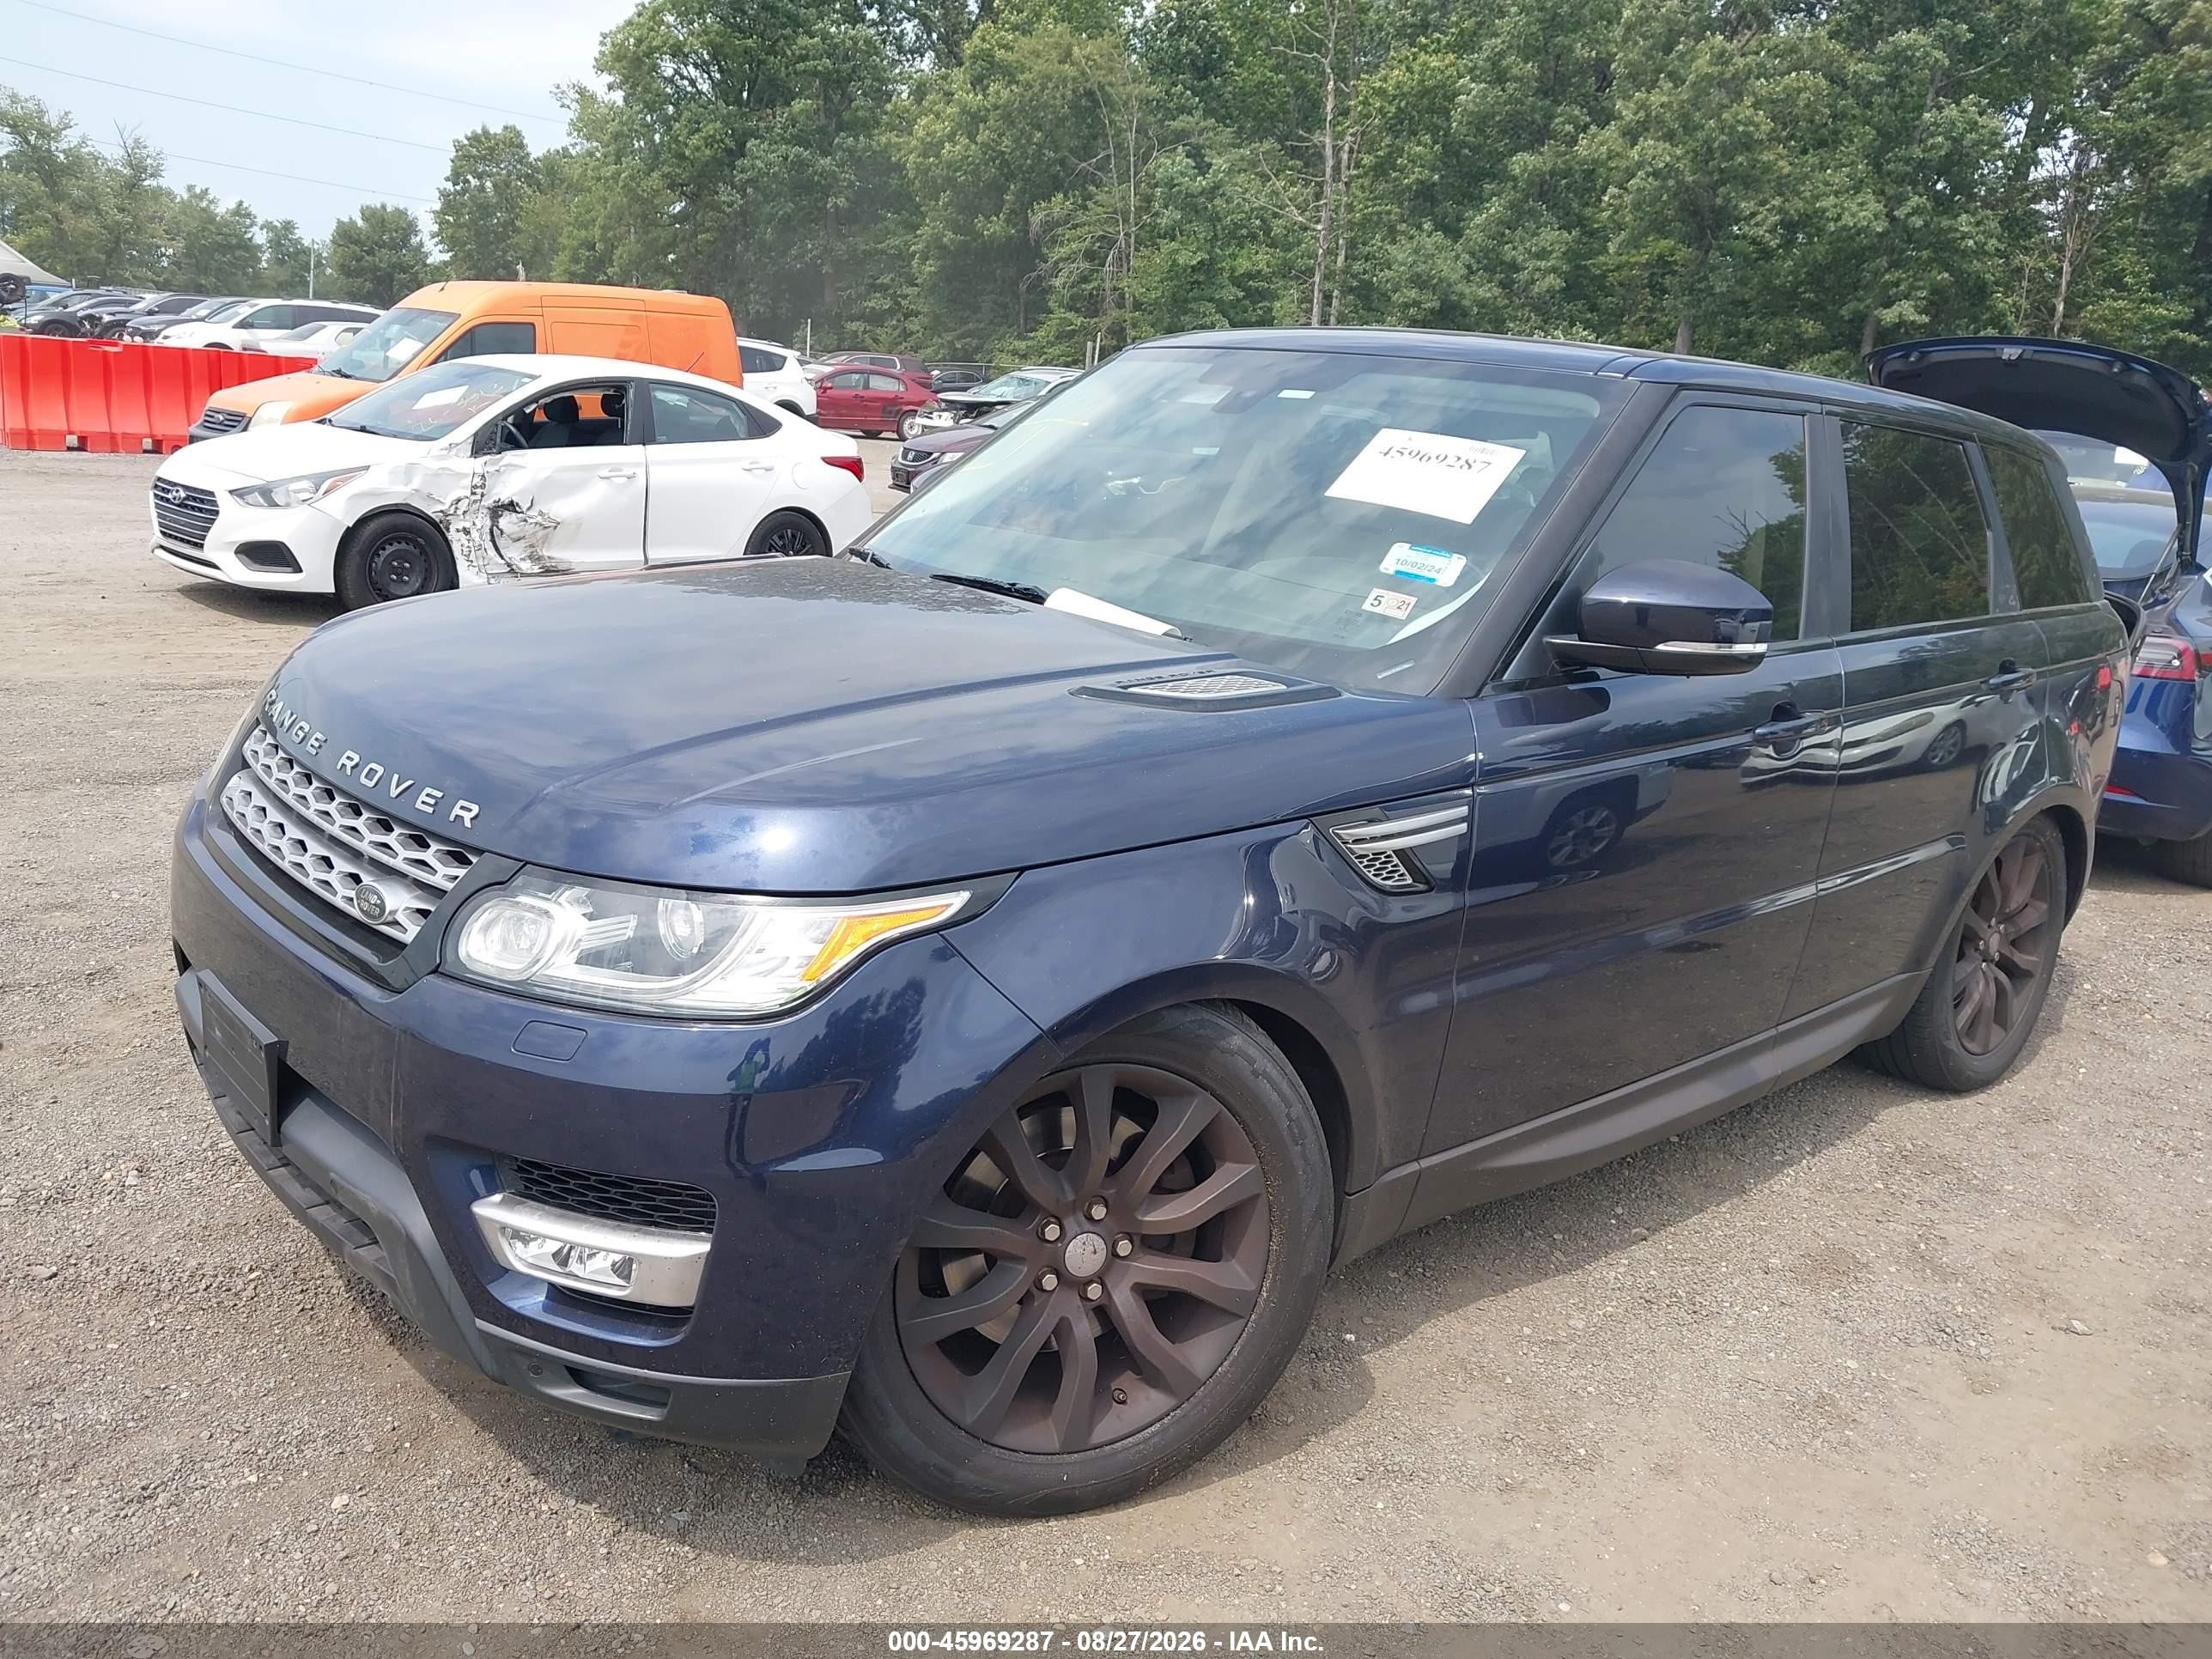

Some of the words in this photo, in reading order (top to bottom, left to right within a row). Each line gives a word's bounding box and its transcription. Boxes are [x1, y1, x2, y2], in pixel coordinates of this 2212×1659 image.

[1379, 446, 1492, 474] 45969287
[1395, 557, 1443, 574] 10/02/24
[1370, 594, 1385, 608] 5
[1396, 599, 1412, 612] 21
[264, 689, 328, 757] RANGE
[336, 749, 482, 830] ROVER
[361, 888, 378, 904] LAND
[359, 899, 380, 917] ROVER
